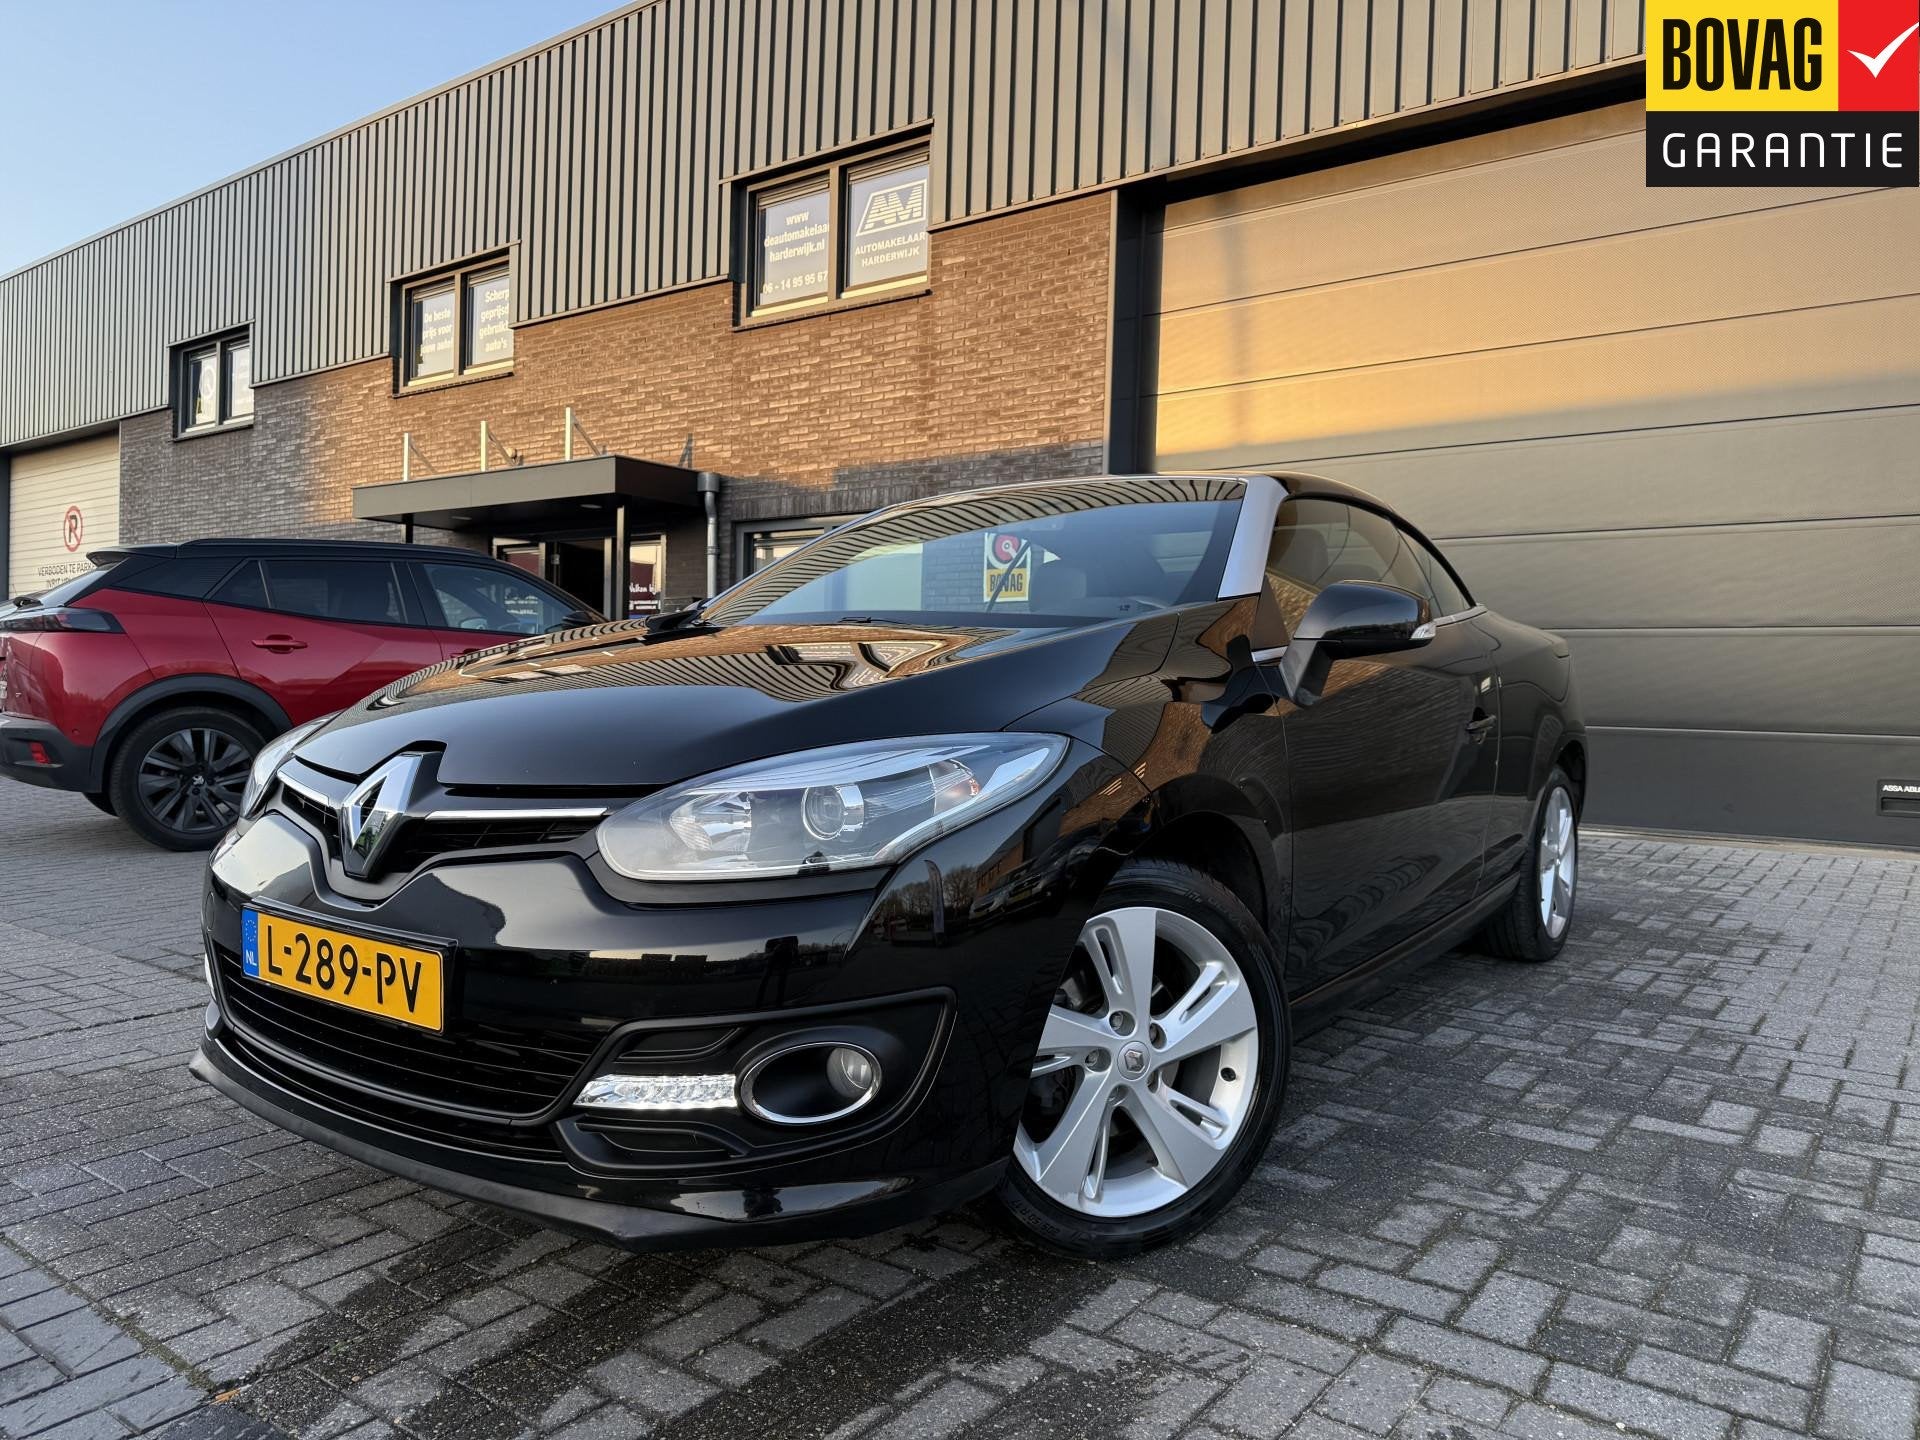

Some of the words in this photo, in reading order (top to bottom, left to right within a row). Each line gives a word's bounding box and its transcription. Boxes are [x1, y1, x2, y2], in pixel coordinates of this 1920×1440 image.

[786, 211, 809, 226] www
[769, 238, 825, 263] harderwijk.nl
[855, 231, 926, 257] AUTOMAKELAAR
[862, 246, 920, 268] HARDERWIJK
[781, 279, 791, 290] 14
[805, 273, 815, 285] 95
[38, 564, 67, 576] VERBODEN
[69, 563, 76, 574] TE
[245, 950, 257, 966] NL
[267, 925, 422, 1013] L-289-PV
